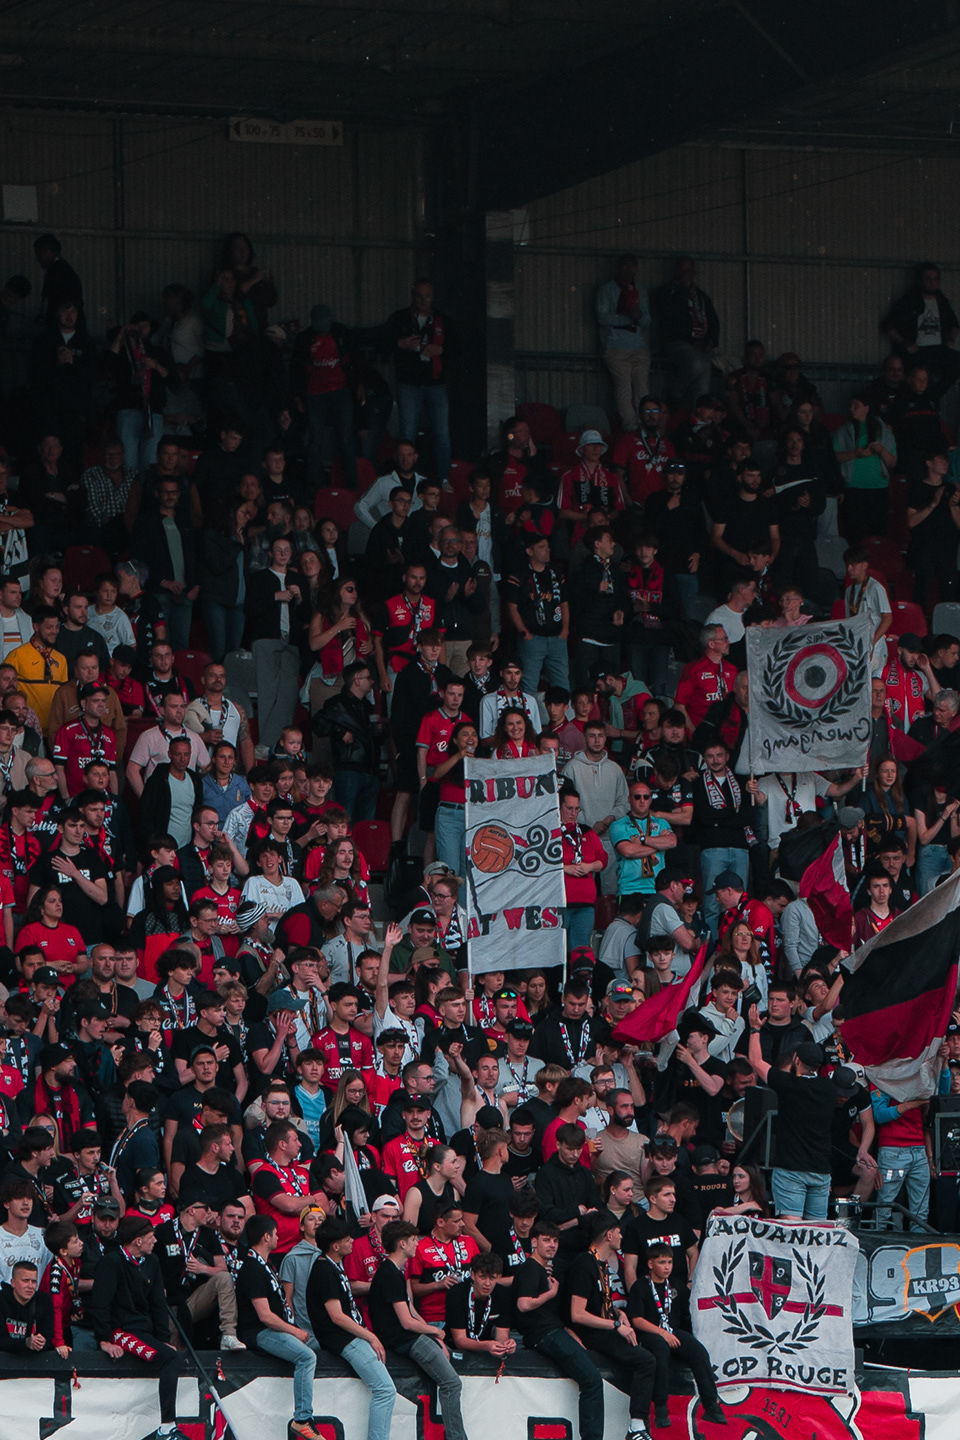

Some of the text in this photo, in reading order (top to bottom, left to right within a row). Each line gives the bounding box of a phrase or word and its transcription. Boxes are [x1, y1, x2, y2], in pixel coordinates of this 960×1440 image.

[464, 770, 559, 804] RIBUN
[701, 1183, 727, 1192] ROUGE
[912, 1276, 960, 1295] KR93
[767, 1356, 848, 1387] ROUGE
